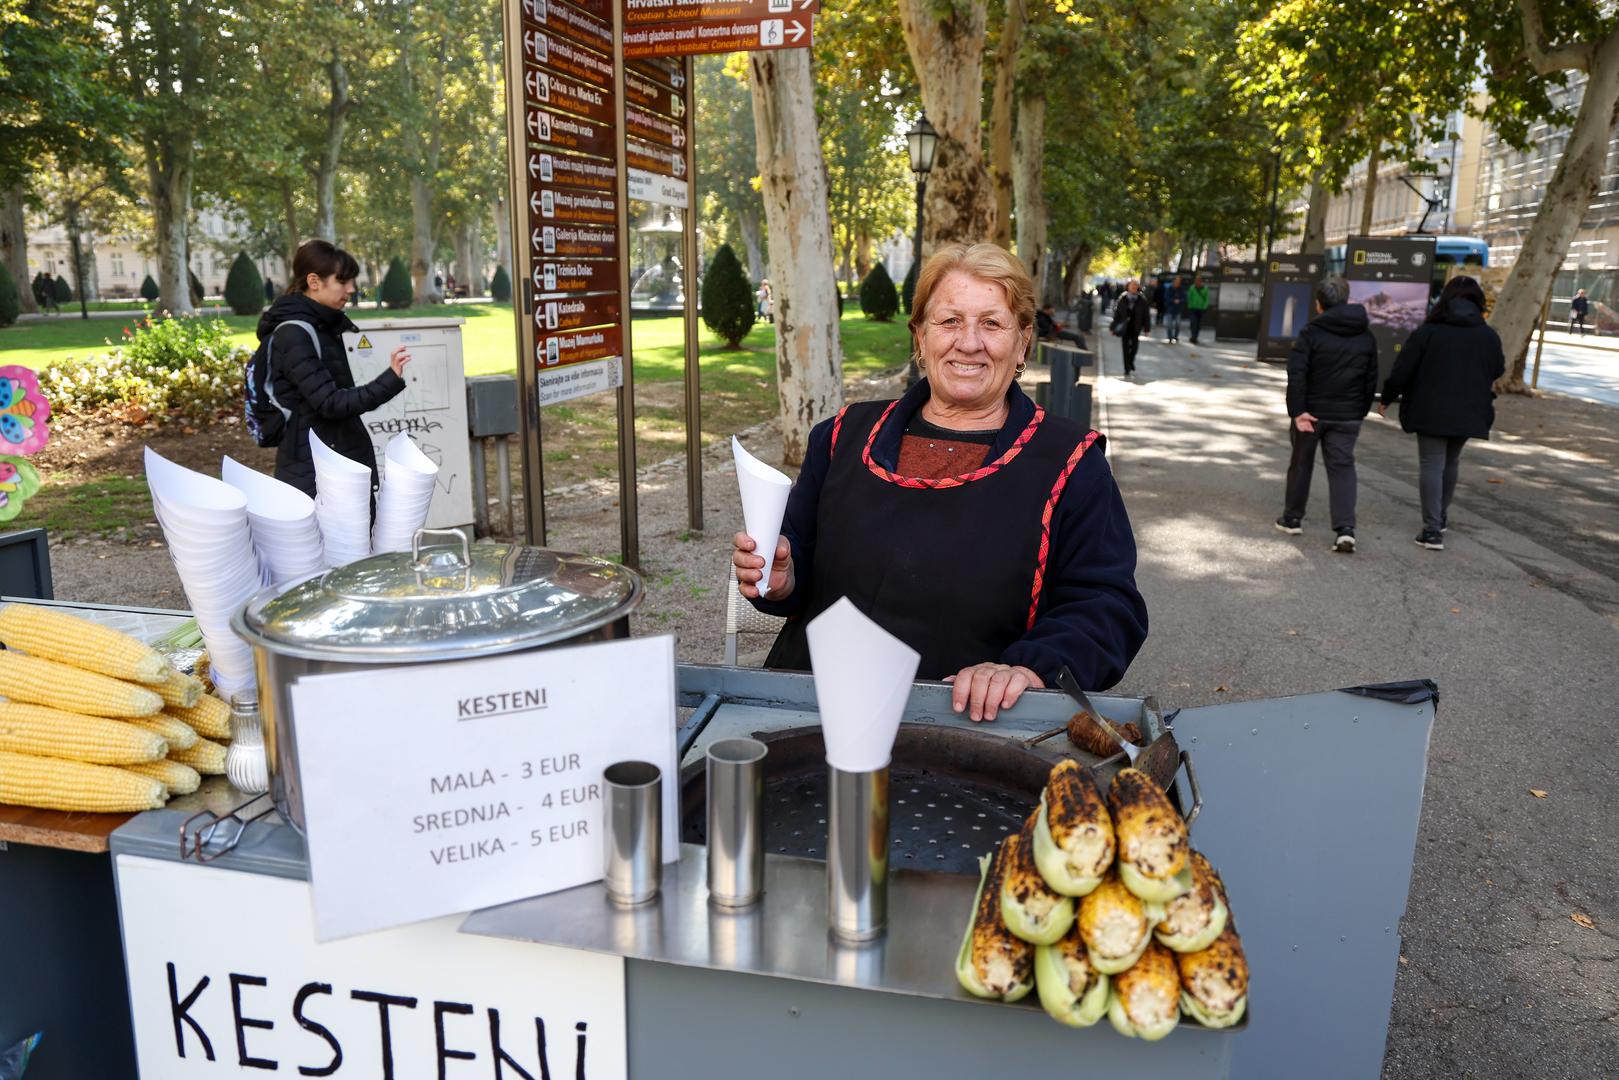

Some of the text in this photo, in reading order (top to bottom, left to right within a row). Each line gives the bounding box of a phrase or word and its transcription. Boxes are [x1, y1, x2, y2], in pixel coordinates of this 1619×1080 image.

[627, 5, 742, 20] Croatian School Museum
[623, 30, 648, 43] Hrvatski
[649, 28, 674, 44] glazbeni
[698, 25, 730, 38] Koncertna
[731, 23, 758, 35] dvorana
[711, 39, 741, 49] Concert
[549, 76, 567, 94] Crkva
[577, 86, 594, 103] Marka
[550, 115, 578, 134] Kamenita
[554, 191, 573, 208] Muzej
[555, 228, 577, 243] Galerija
[577, 264, 593, 276] Dolac
[558, 301, 585, 314] Katedrala
[457, 688, 548, 717] KESTENI
[430, 768, 495, 794] MALA
[521, 762, 533, 779] 3
[540, 753, 581, 775] EUR
[413, 801, 510, 833] SREDNJA
[541, 793, 553, 809] 4
[560, 784, 600, 806] EUR
[430, 837, 505, 865] VELIKA
[530, 829, 542, 847] 5
[549, 820, 589, 843] EUR
